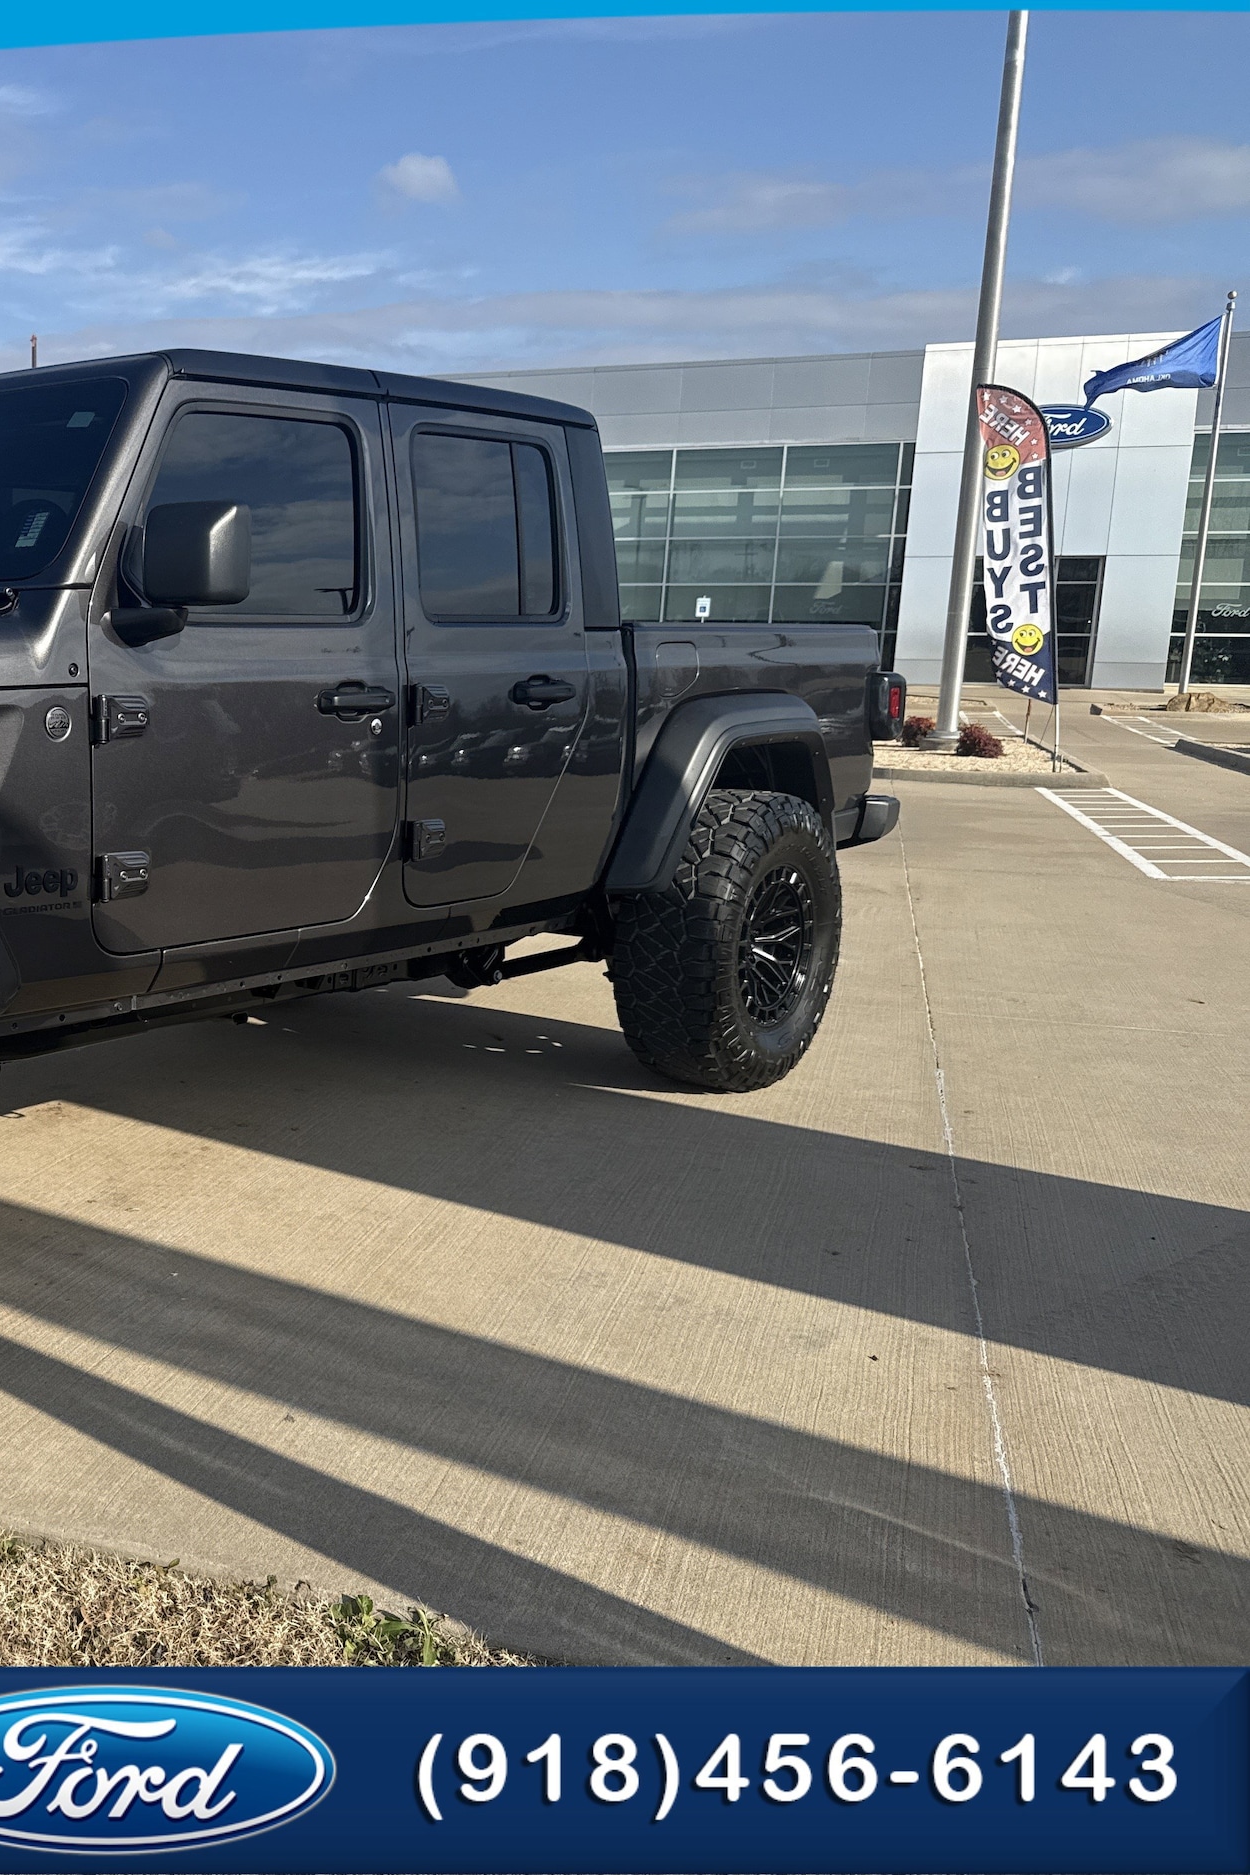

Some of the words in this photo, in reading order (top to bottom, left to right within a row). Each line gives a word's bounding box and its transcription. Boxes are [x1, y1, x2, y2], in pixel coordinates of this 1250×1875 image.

[809, 601, 843, 615] Ford
[1211, 602, 1250, 617] Ford
[3, 865, 78, 898] Jeep
[2, 901, 71, 916] GLADIATOR
